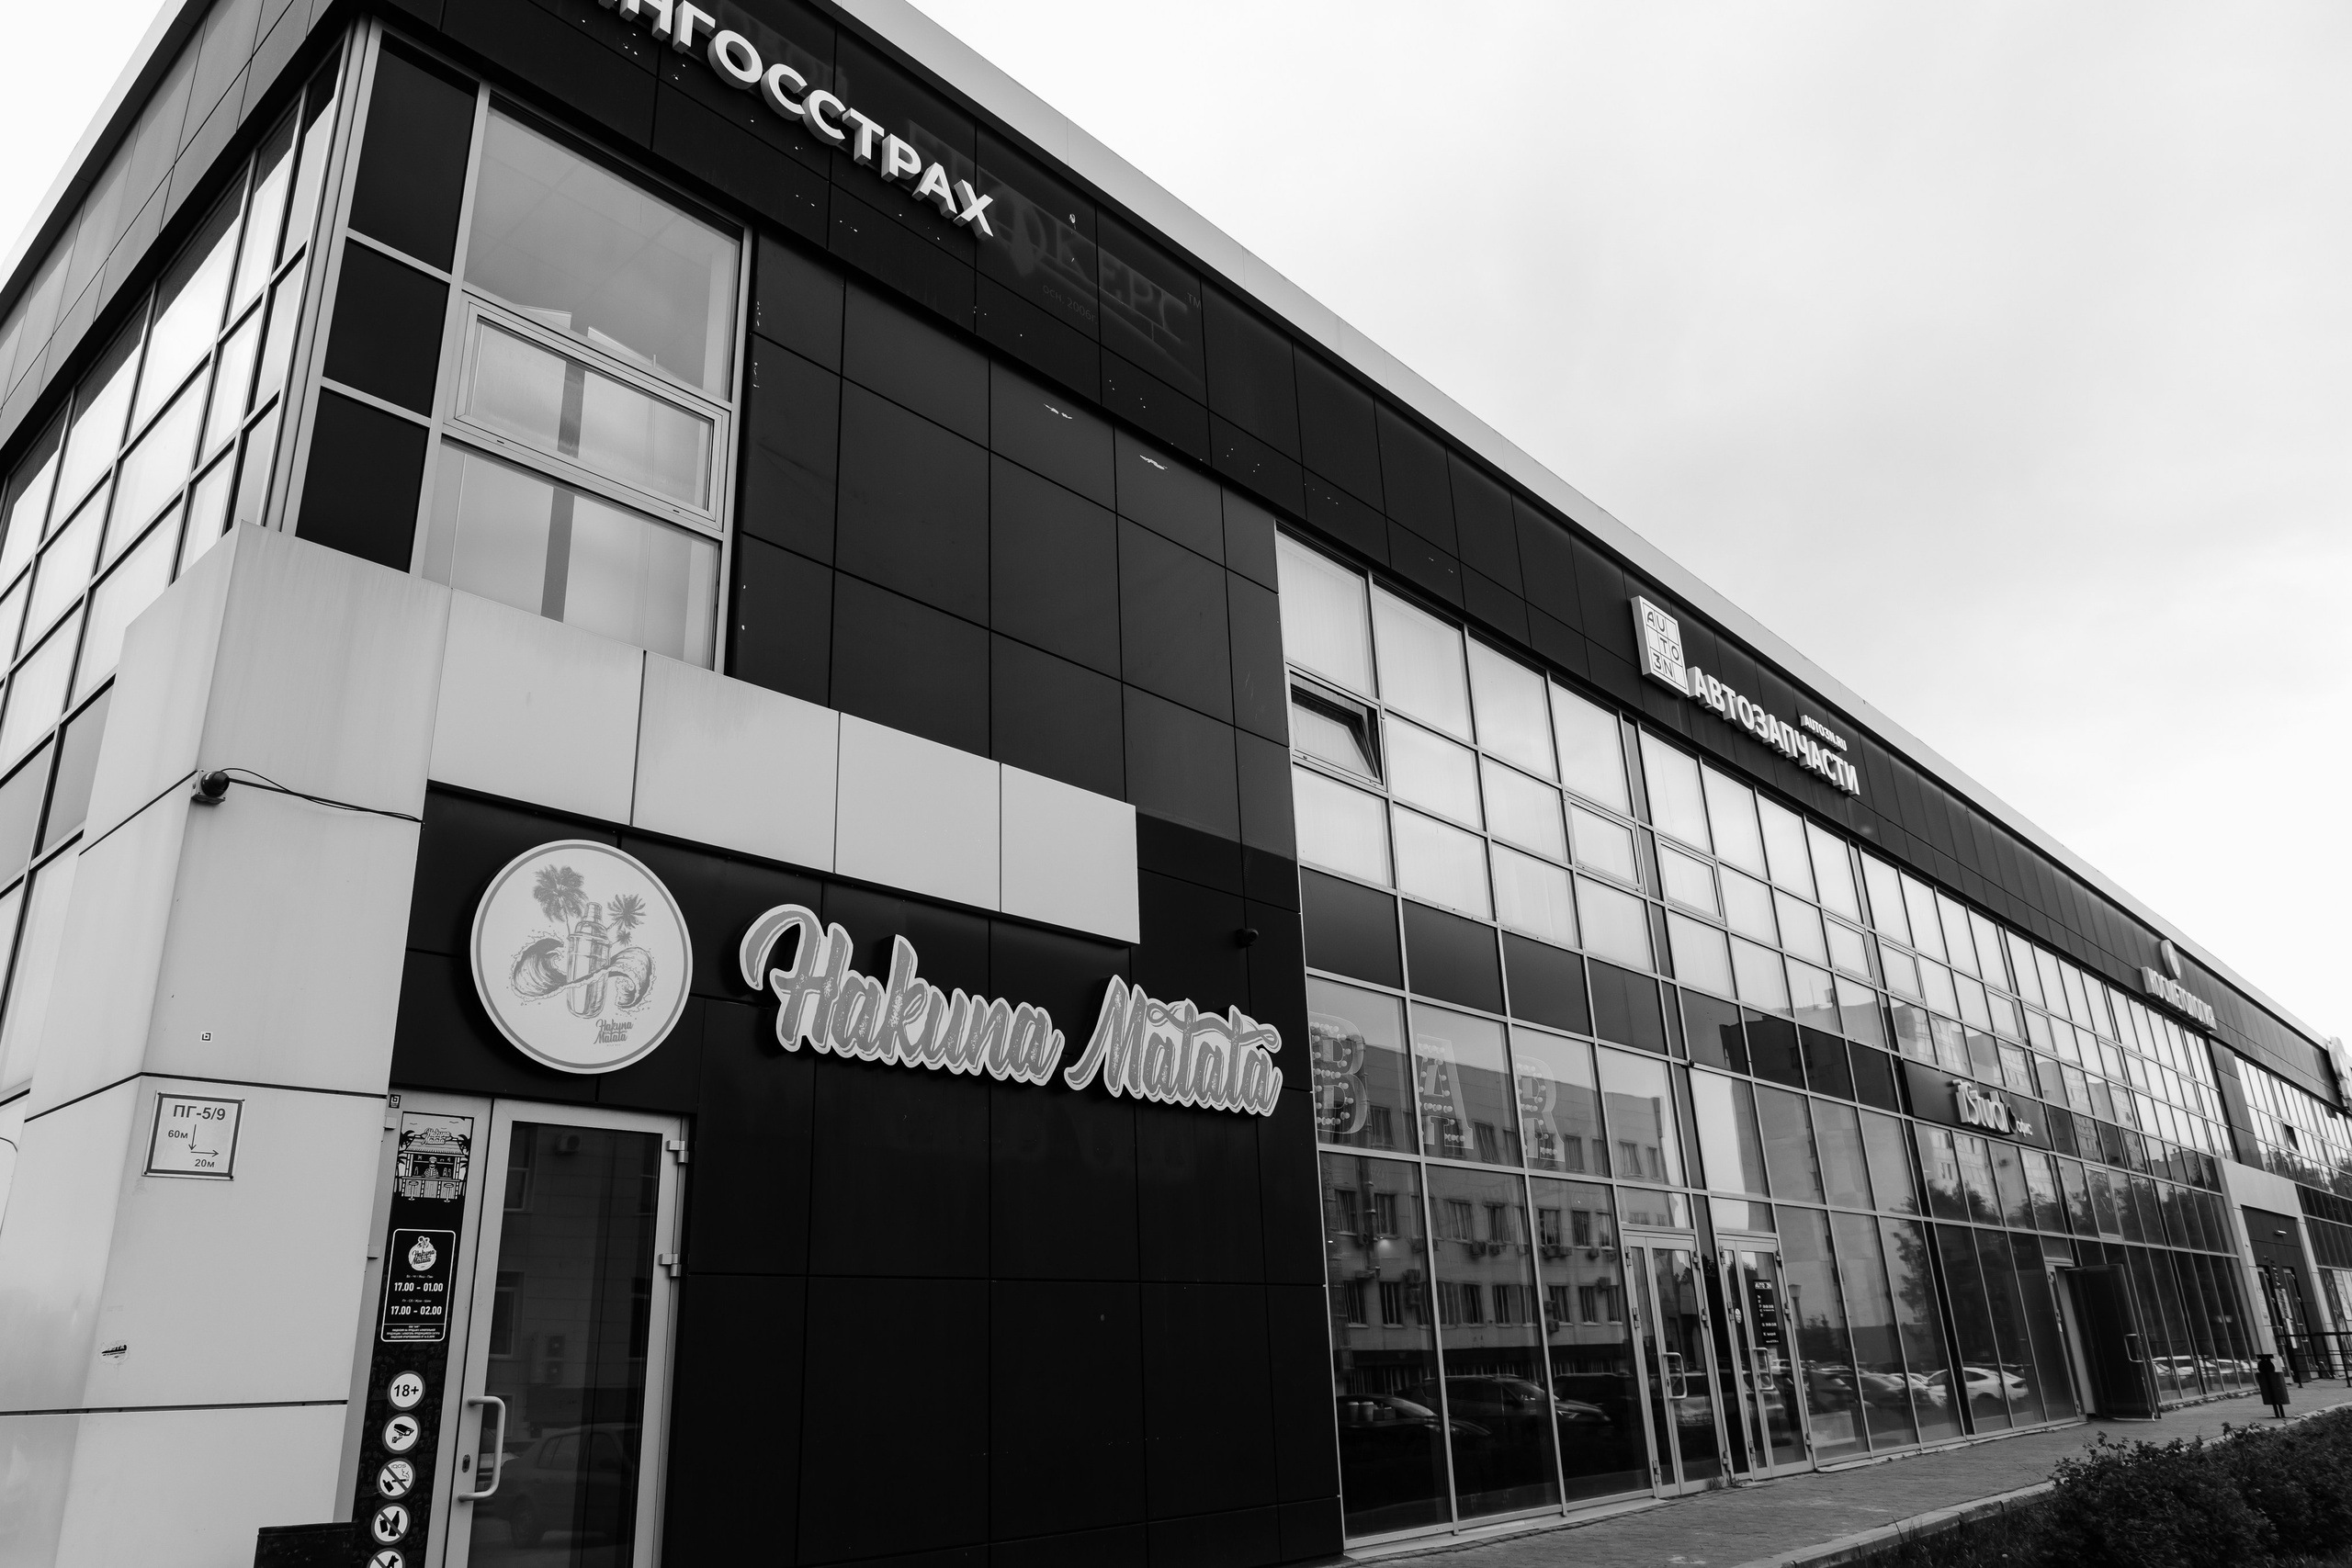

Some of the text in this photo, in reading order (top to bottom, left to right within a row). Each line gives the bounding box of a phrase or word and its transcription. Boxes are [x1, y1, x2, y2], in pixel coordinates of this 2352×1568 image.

[598, 0, 994, 240] НГОССТРАХ
[1689, 666, 1860, 796] АВТОЗАПЧАСТИ
[740, 904, 1283, 1118] Hakuna Matata
[595, 1018, 634, 1032] Hakuna
[594, 1030, 628, 1045] Matata
[173, 1104, 226, 1121] ПГ-5/9
[167, 1129, 188, 1139] 60м
[194, 1158, 215, 1168] 20м
[394, 1281, 414, 1292] 17.00
[423, 1282, 444, 1292] 01.00
[390, 1305, 412, 1315] 17.00
[420, 1305, 442, 1315] 02.00
[393, 1383, 420, 1397] 18+
